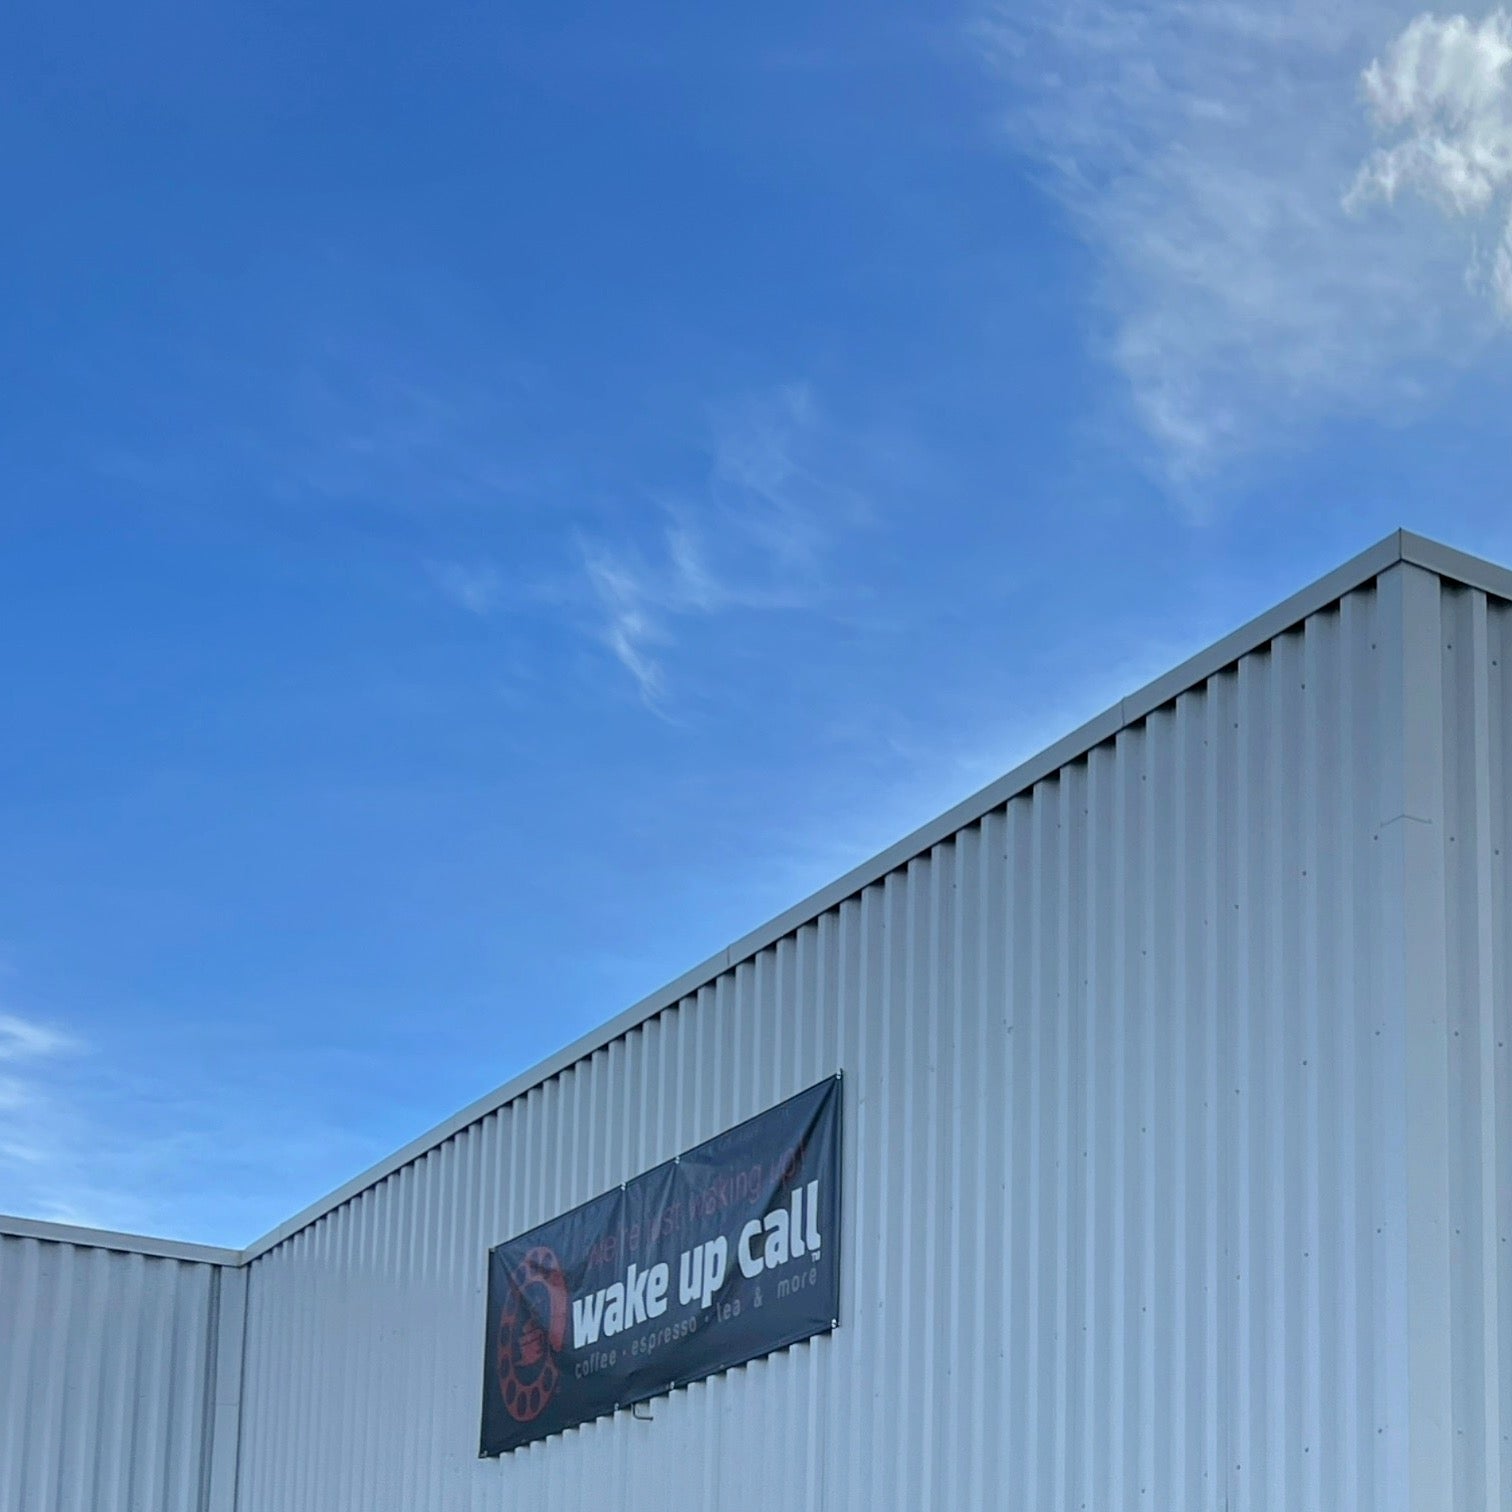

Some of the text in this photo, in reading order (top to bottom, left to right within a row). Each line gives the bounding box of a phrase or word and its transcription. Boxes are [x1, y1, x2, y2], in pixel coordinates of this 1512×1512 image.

[571, 1263, 668, 1350] wake
[679, 1234, 728, 1309] up
[737, 1180, 822, 1279] call
[575, 1346, 617, 1380] coffee
[631, 1314, 698, 1356] espresso
[716, 1297, 741, 1325] tea
[777, 1265, 818, 1299] more
